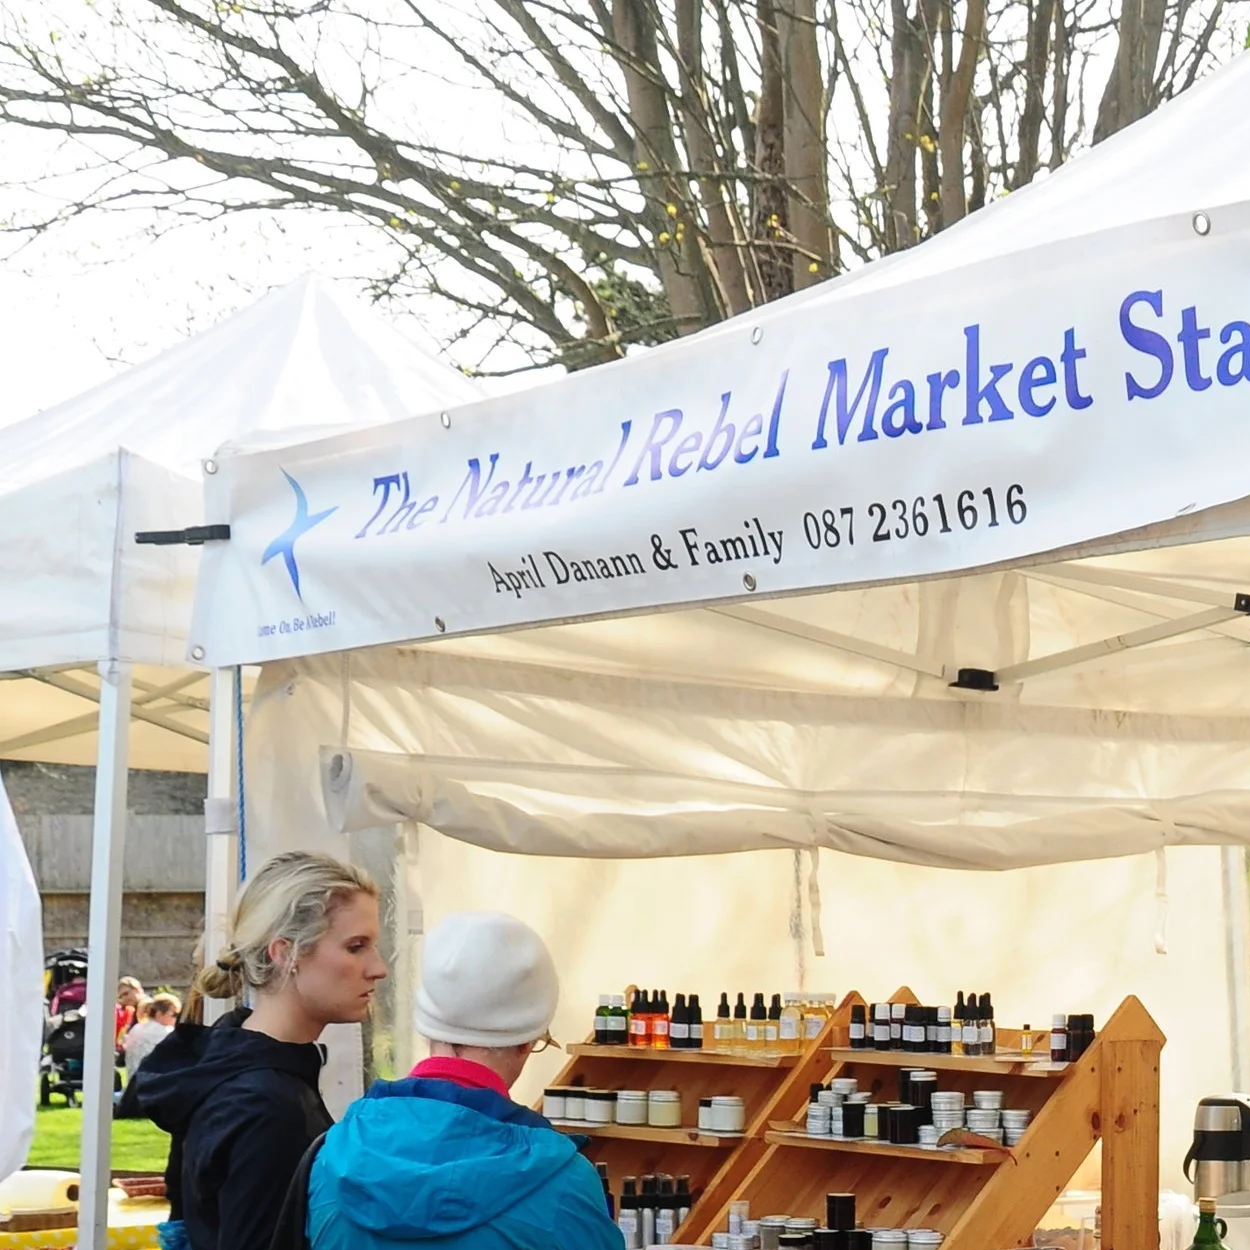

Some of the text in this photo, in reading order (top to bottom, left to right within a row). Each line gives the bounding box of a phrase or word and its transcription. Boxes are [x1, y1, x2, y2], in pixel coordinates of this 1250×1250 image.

[354, 471, 440, 540] The
[439, 419, 633, 524] Natural
[622, 367, 790, 487] Rebel
[811, 323, 1094, 451] Market
[487, 483, 1029, 600] April Danann & Family 087 2361616
